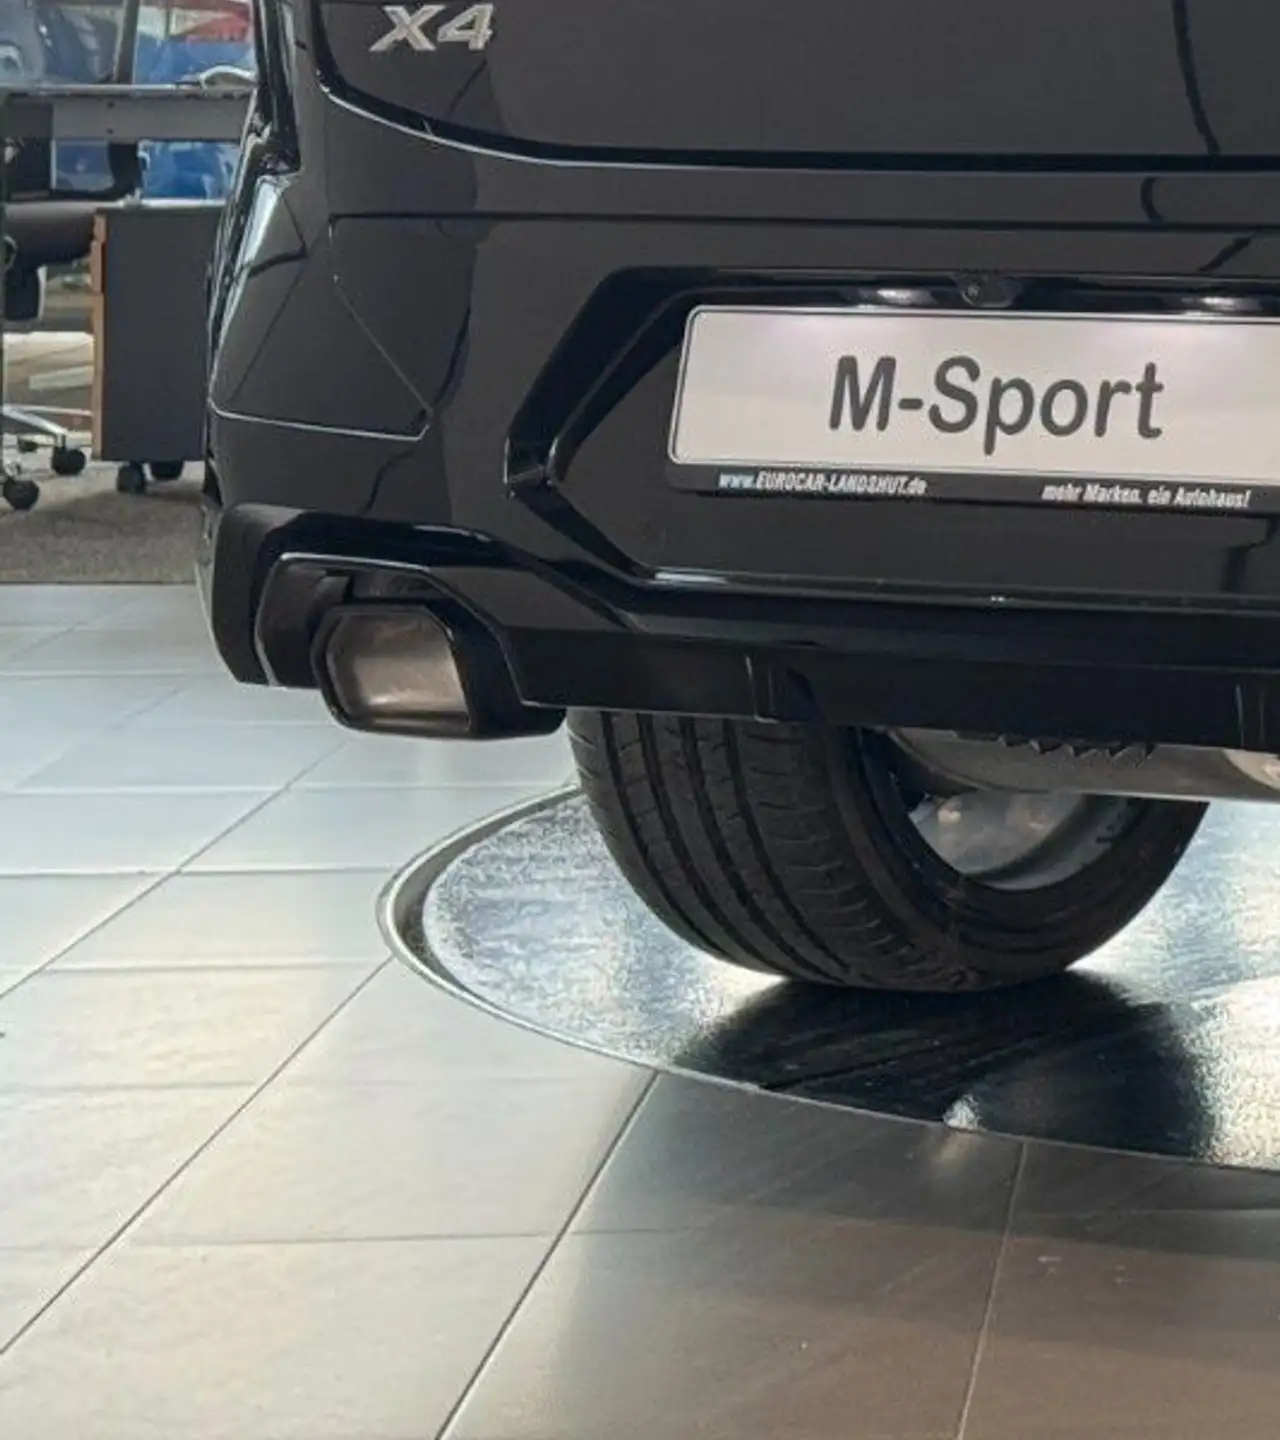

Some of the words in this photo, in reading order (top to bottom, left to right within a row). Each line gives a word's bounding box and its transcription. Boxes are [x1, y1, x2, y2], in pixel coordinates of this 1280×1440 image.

[369, 3, 494, 52] X4
[829, 355, 1164, 456] M-Sport
[1042, 482, 1082, 502] mehr
[1146, 485, 1172, 506] ein
